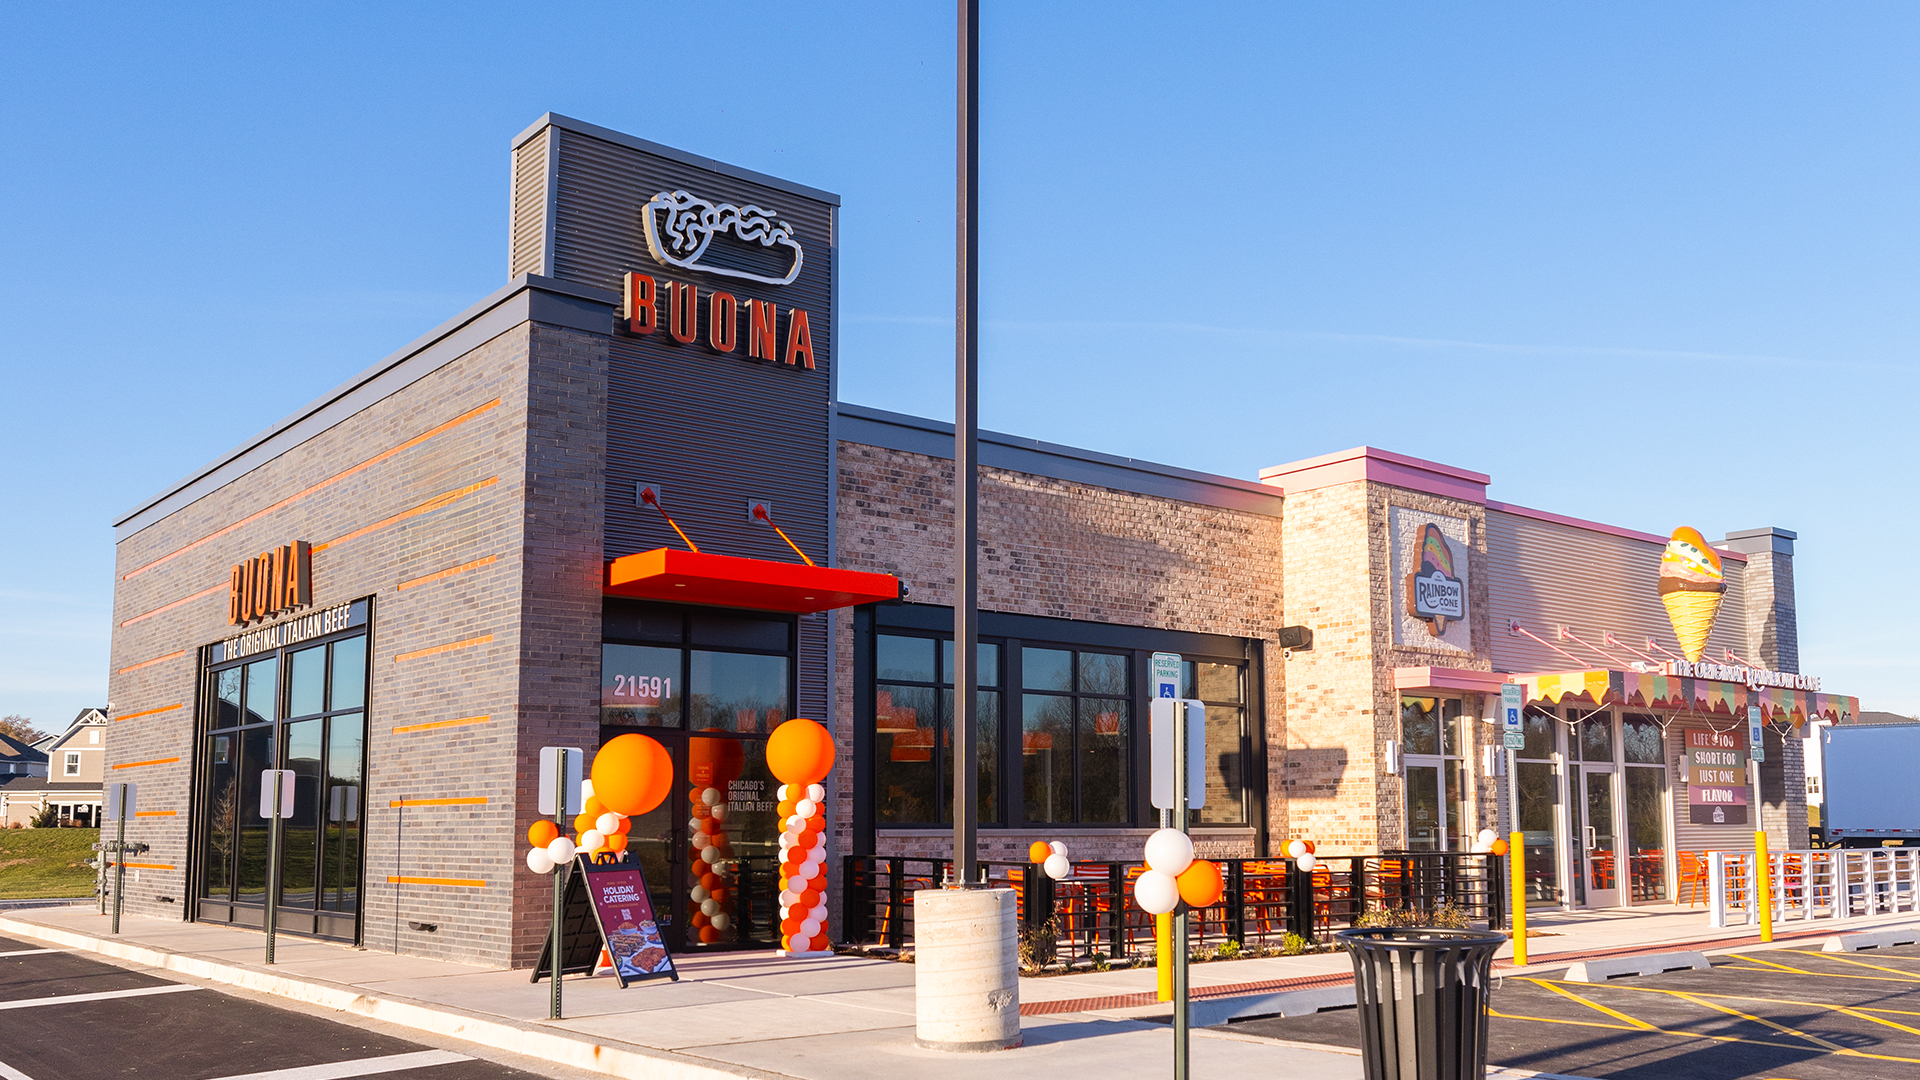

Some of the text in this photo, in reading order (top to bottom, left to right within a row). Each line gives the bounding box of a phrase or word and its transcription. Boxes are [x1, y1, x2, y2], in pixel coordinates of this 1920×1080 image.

[627, 271, 815, 369] BUONA
[228, 540, 301, 626] BUONA
[1419, 582, 1459, 606] RAINBOW
[1439, 597, 1458, 608] CONE
[223, 604, 351, 661] THE ORIGINAL ITALIAN BEEF
[1155, 659, 1180, 669] RESERVED
[1156, 669, 1179, 678] PARKING
[1674, 660, 1823, 691] THE ORIGINAL RAINBOW CONE
[613, 674, 671, 699] 21591
[1718, 734, 1734, 748] TOO
[1695, 751, 1721, 765] SHORT
[1722, 752, 1737, 765] FOR
[1699, 769, 1735, 783] JUST ONE
[728, 780, 765, 791] CHICAGO'S
[728, 791, 760, 801] ORIGINAL
[1702, 789, 1733, 803] FLAVOR
[727, 801, 755, 812] ITALIAN
[602, 885, 634, 895] HOLIDAY
[603, 893, 640, 904] CATERING
